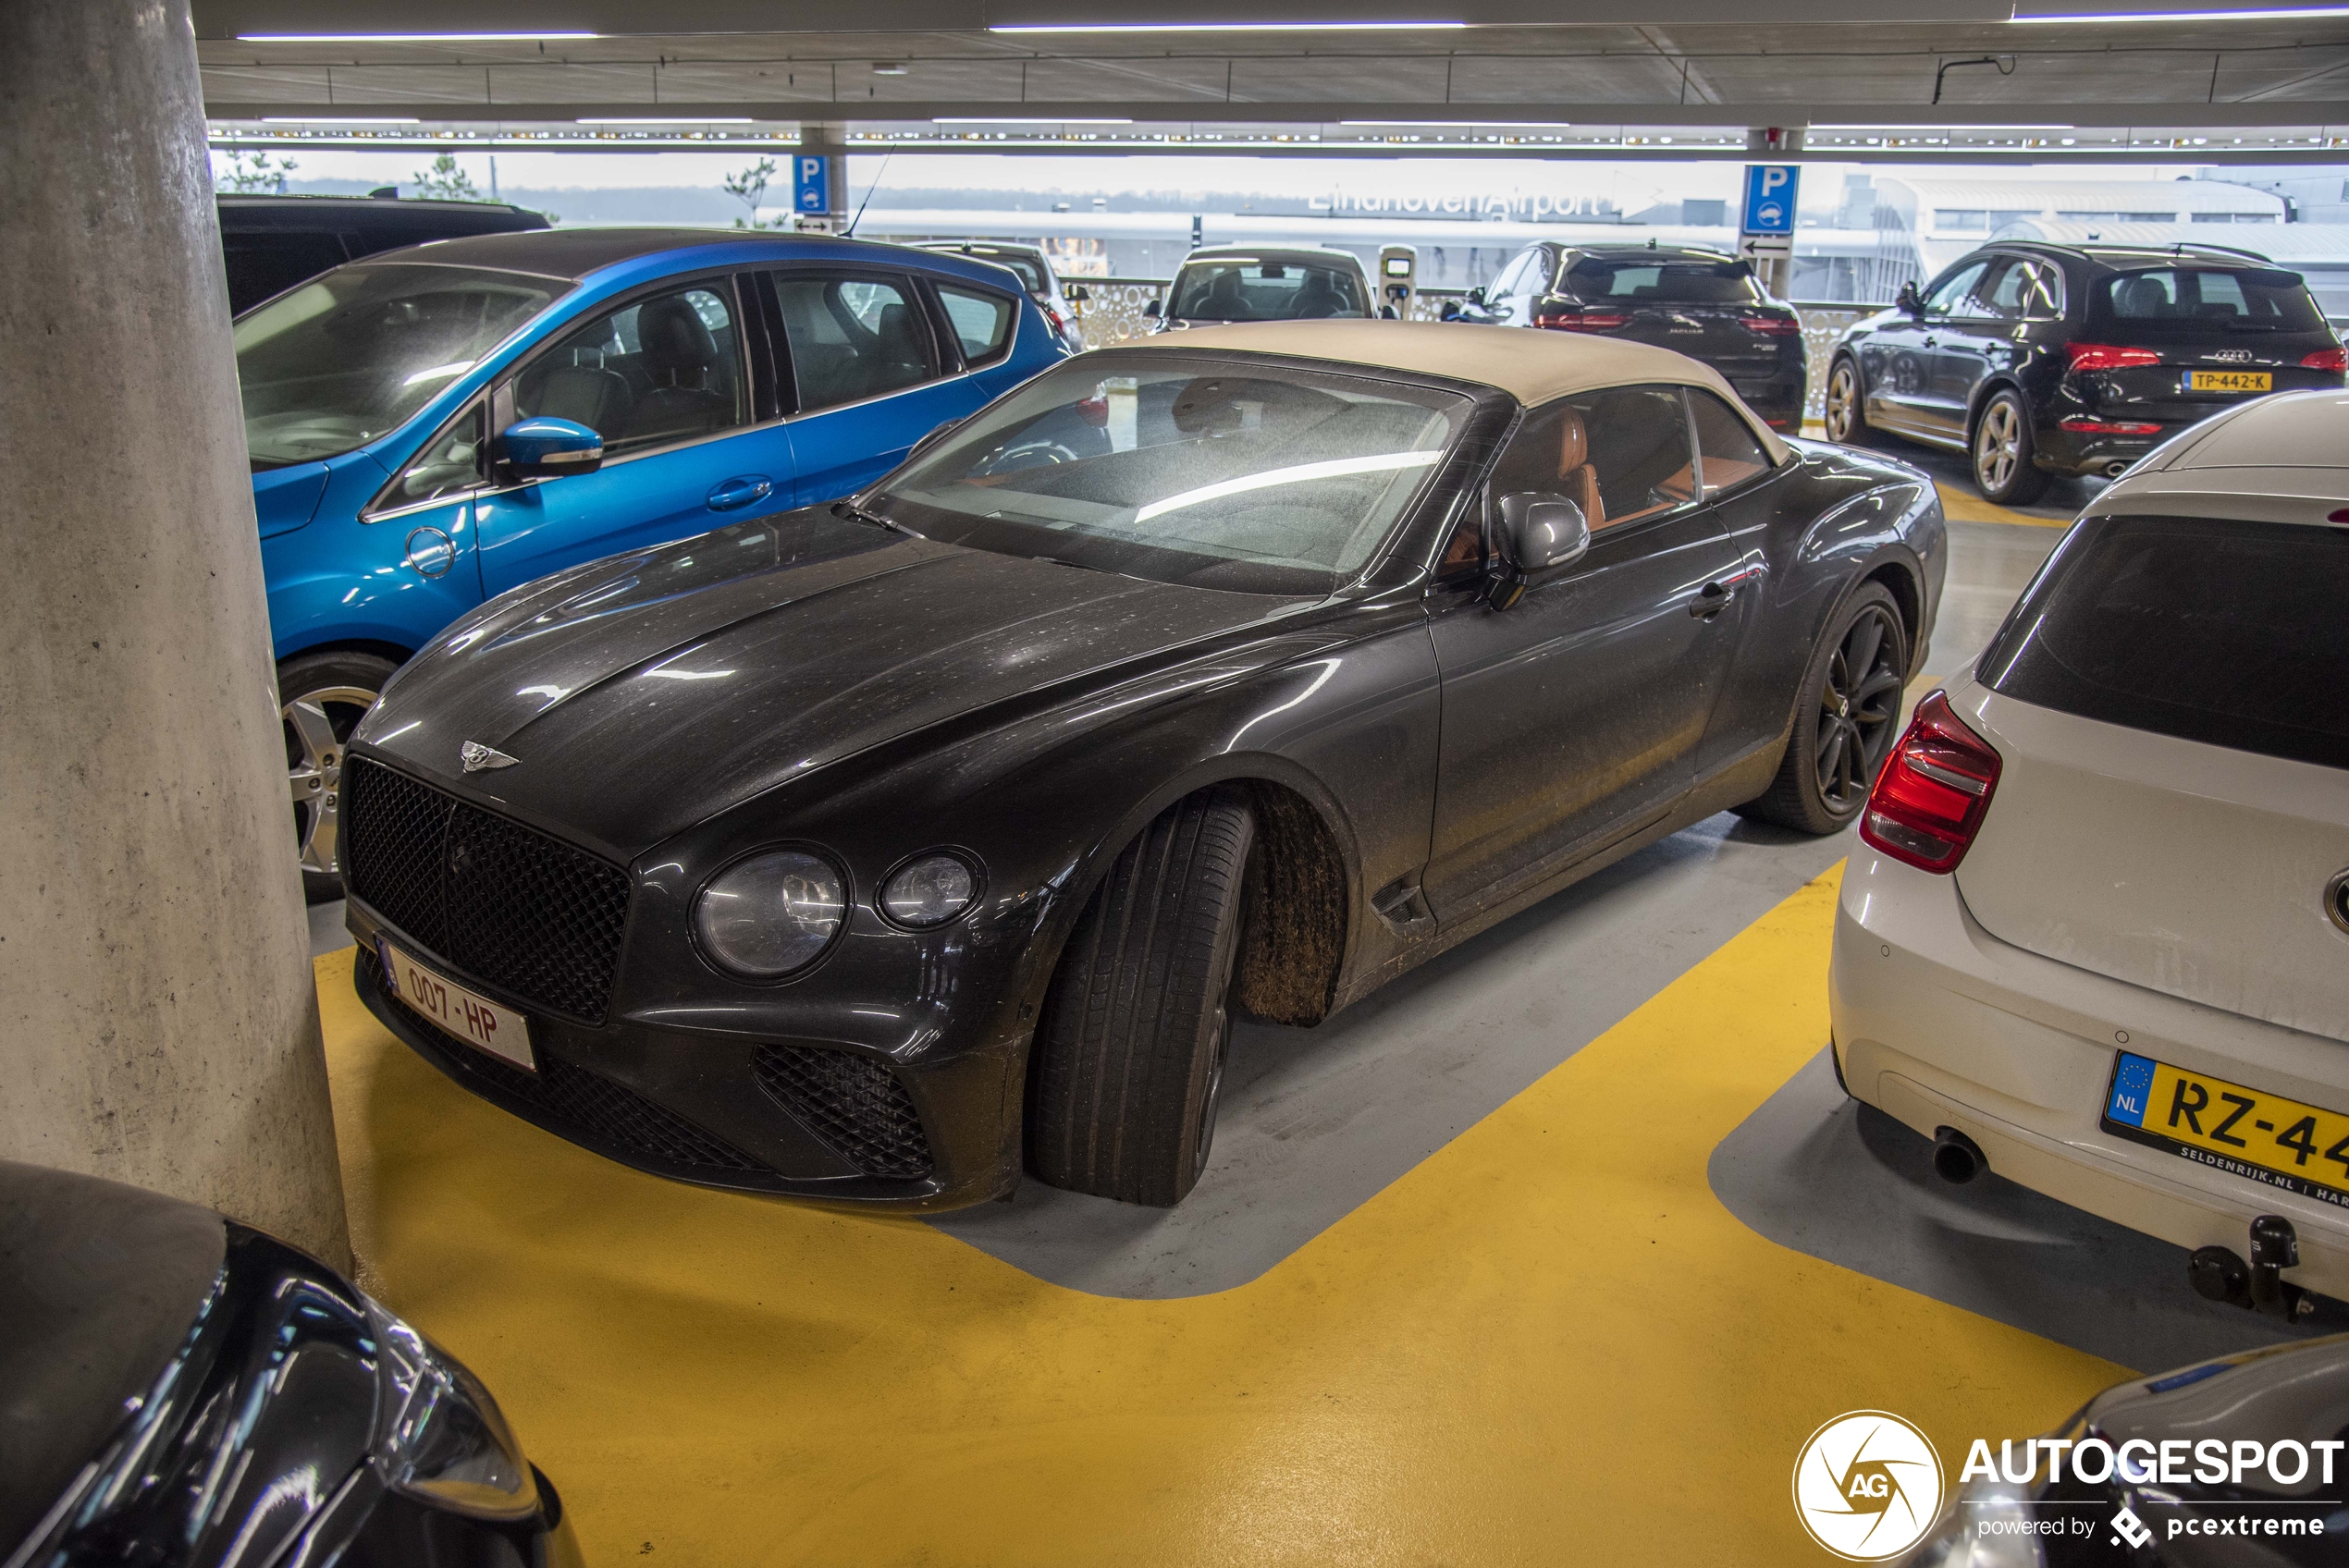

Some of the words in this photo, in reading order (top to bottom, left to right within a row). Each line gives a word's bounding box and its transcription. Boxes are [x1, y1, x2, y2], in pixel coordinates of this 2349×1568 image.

[802, 158, 820, 184] P
[1762, 167, 1789, 197] P
[2196, 374, 2265, 389] TP-442-K
[2116, 1093, 2140, 1115] NL
[2180, 1146, 2294, 1191] SELDENRIJK.NL
